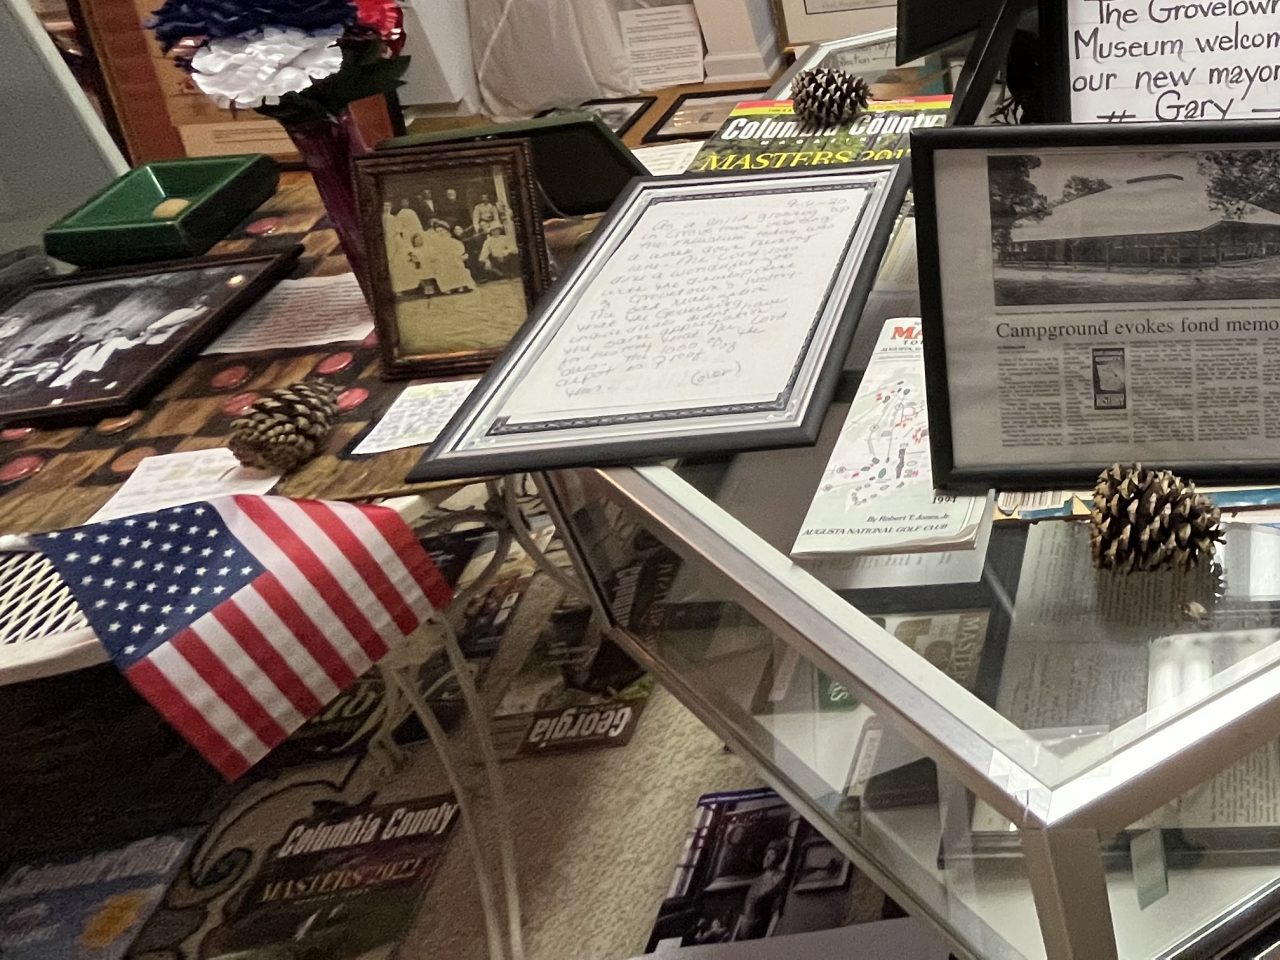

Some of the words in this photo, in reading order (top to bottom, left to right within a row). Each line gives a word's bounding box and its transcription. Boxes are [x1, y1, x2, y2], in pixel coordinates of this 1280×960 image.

[1074, 26, 1185, 63] Museum
[1072, 70, 1118, 92] our
[1135, 67, 1197, 94] new
[1155, 89, 1235, 121] Gary
[700, 150, 856, 172] MASTERS
[996, 319, 1109, 341] Campground
[1115, 317, 1175, 335] evokes
[1181, 315, 1220, 334] fond
[802, 528, 846, 537] AUGUSTA
[952, 615, 982, 684] MASTER
[528, 706, 633, 748] Georgia
[277, 811, 382, 859] Columbia
[381, 801, 460, 841] County
